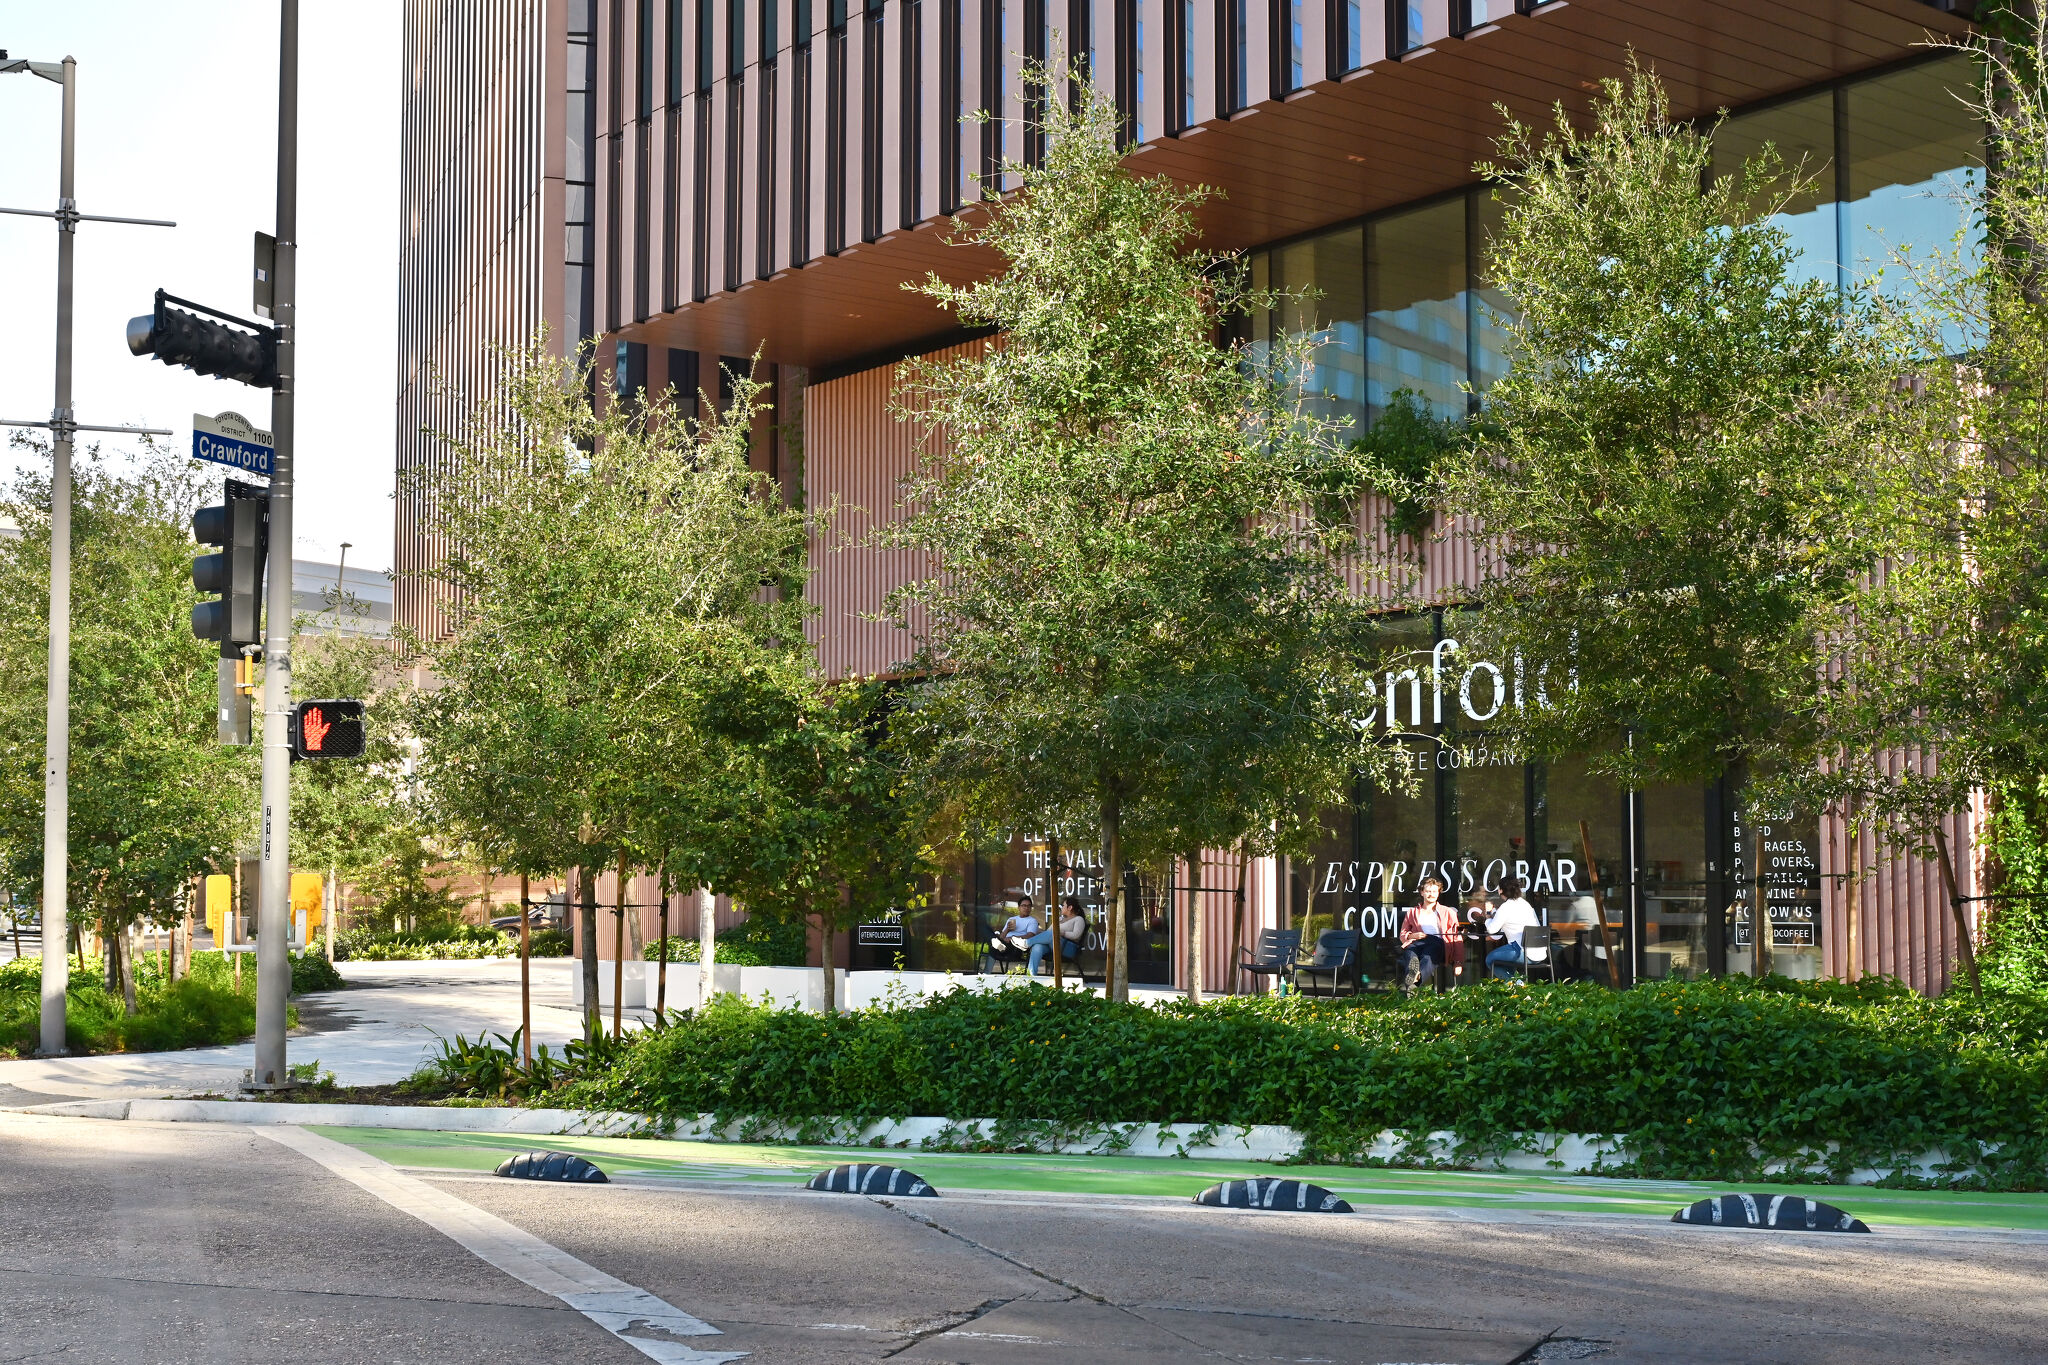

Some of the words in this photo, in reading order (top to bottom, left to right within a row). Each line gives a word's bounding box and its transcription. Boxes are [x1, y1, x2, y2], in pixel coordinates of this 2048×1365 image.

[215, 413, 233, 425] TOYOTA
[234, 415, 253, 434] CENTER
[221, 426, 246, 438] DISTRICT
[253, 432, 273, 445] 1100
[199, 436, 268, 470] Crawford
[1436, 747, 1520, 771] COMPAN
[1734, 840, 1806, 855] BRAGES,
[1772, 856, 1815, 870] OVERS,
[1320, 858, 1507, 894] ESPRESSO
[1515, 859, 1577, 893] BAR
[1735, 872, 1808, 887] CTAILS,
[1023, 877, 1043, 896] OF
[1766, 888, 1796, 899] WINE
[1736, 906, 1790, 918] FOOW
[1795, 906, 1812, 918] US
